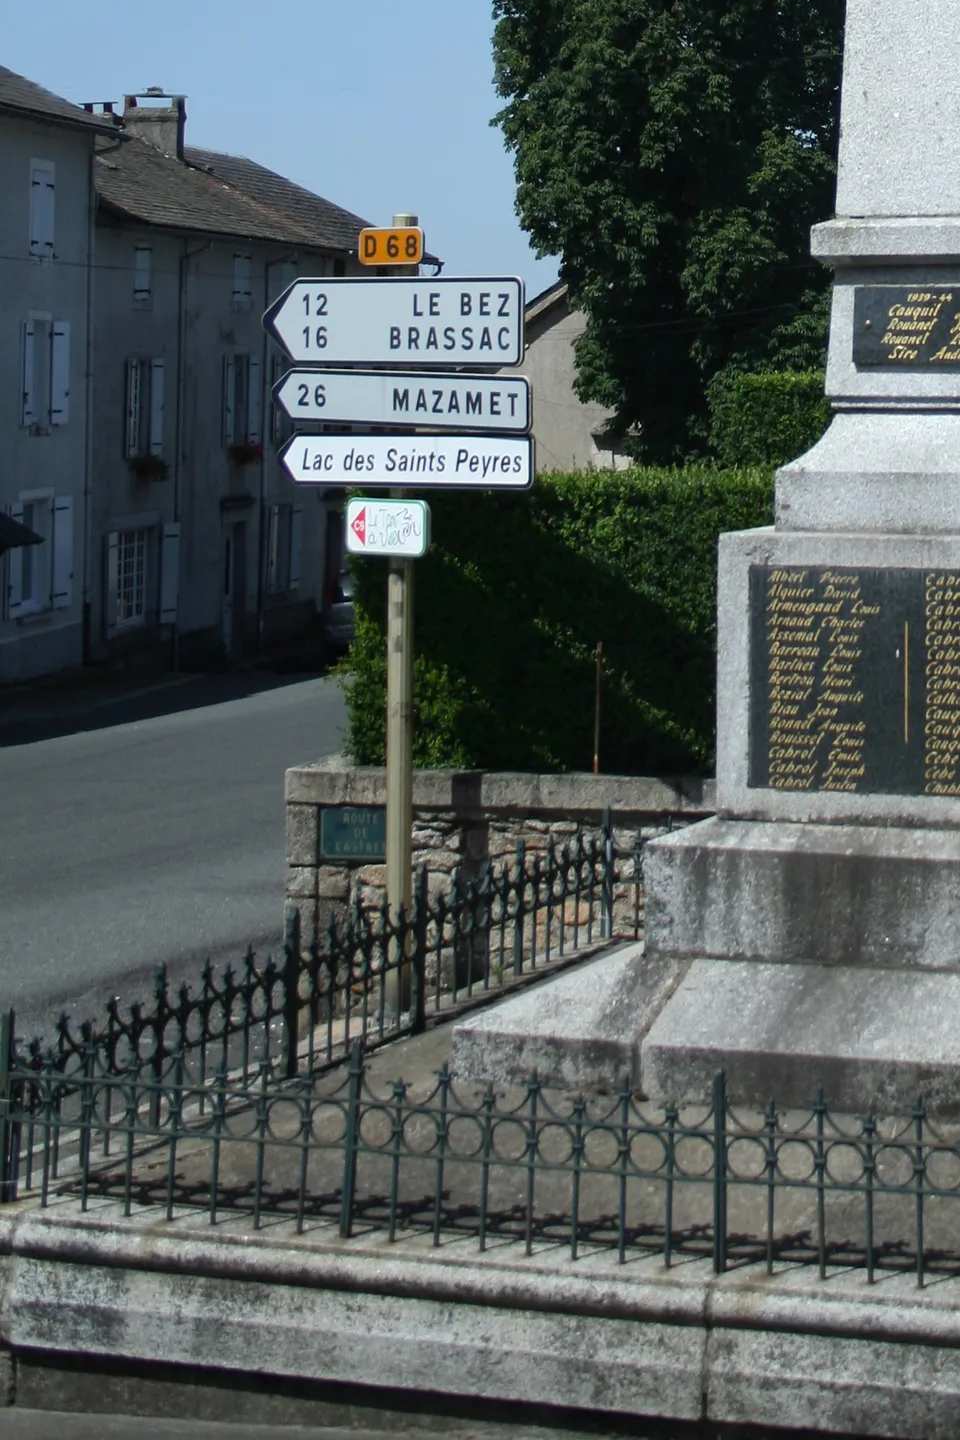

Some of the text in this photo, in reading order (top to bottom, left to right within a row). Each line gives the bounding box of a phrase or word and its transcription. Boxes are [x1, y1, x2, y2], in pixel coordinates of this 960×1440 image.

[365, 234, 417, 258] D 68
[302, 293, 511, 316] 12 LE BEZ
[889, 303, 942, 320] Cauquil
[887, 318, 938, 331] Rouanet
[302, 326, 511, 350] 16 BRASSAC
[880, 332, 930, 344] Rouanet
[298, 384, 519, 416] 26 MAZAMET
[302, 448, 522, 478] Lac des Saints Peyres
[823, 585, 861, 599] David
[767, 614, 814, 628] Arnaud
[822, 658, 853, 672] Louis
[807, 703, 838, 718] Jean
[768, 746, 816, 759] Cabrol
[768, 760, 818, 773] Cabrol
[768, 775, 815, 787] Cabrol
[343, 813, 380, 824] ROUTE
[354, 828, 368, 838] DE
